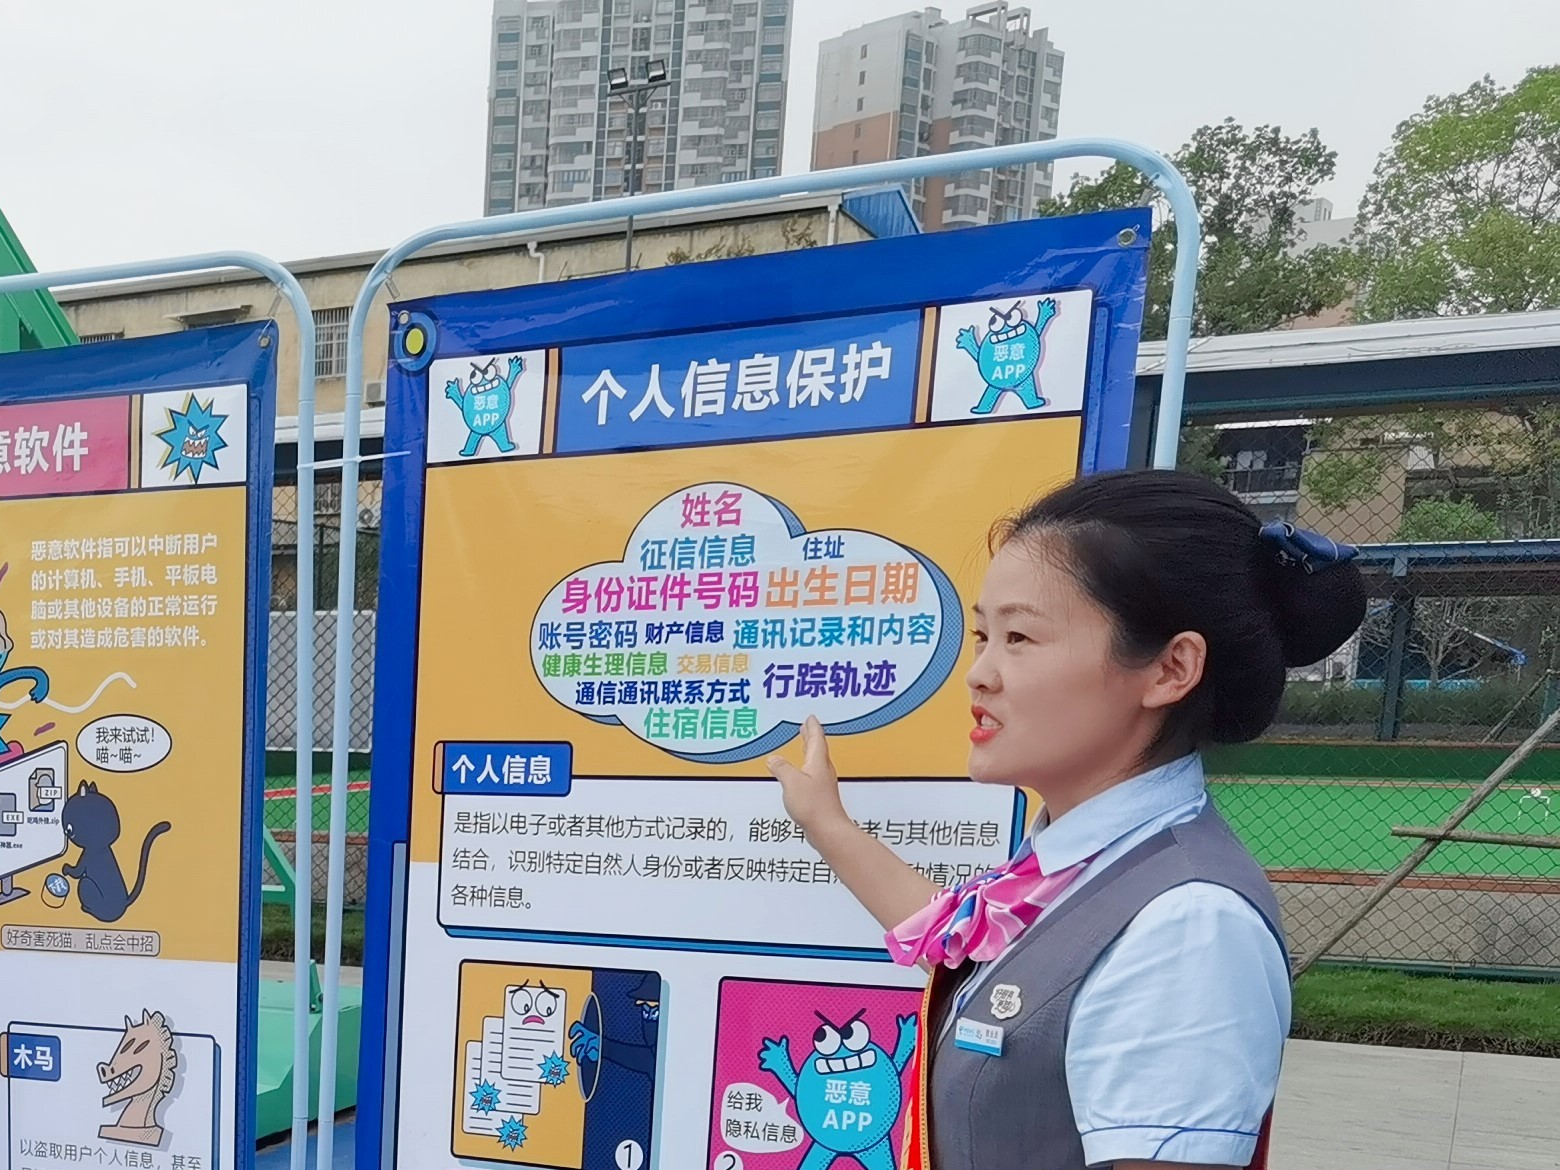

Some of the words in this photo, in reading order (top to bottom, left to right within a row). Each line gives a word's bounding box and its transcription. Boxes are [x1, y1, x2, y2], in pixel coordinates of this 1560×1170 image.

[992, 342, 1025, 362] 恶意
[581, 341, 892, 426] 个人信息保护
[990, 362, 1027, 382] APP
[473, 392, 500, 411] 恶意
[472, 411, 501, 429] APP
[680, 490, 744, 528] 姓名
[30, 533, 219, 562] 恶意软件指可以中断用户
[640, 534, 756, 571] 征信信息
[802, 536, 846, 561] 住址
[31, 562, 219, 592] 的计算机、手机、平板电
[765, 561, 920, 609] 出生日期
[561, 571, 761, 615] 身份证件号码
[31, 594, 219, 622] 脑或其他设备的正常运行
[31, 625, 207, 650] 或对其造成危害的软件。
[538, 619, 639, 650] 账号密码
[644, 620, 724, 646] 财产信息
[732, 613, 936, 651] 通讯记录和内容
[541, 652, 669, 678] 健康生理信息
[676, 653, 750, 675] 交易信息
[575, 679, 752, 706] 通信通讯联系方式
[762, 661, 898, 699] 行踪轨迹
[643, 707, 759, 741] 住宿信息
[451, 755, 553, 785] 个人信息
[44, 788, 58, 797] ZIP
[6, 813, 20, 822] EXE
[450, 885, 534, 912] 各种信息。
[6, 929, 155, 954] 好奇害死猫，乱点会中招
[13, 1045, 53, 1073] 木马
[727, 1091, 763, 1114] 给我
[825, 1079, 872, 1106] 恶意
[726, 1117, 799, 1144] 隐私信息
[822, 1108, 873, 1133] APP
